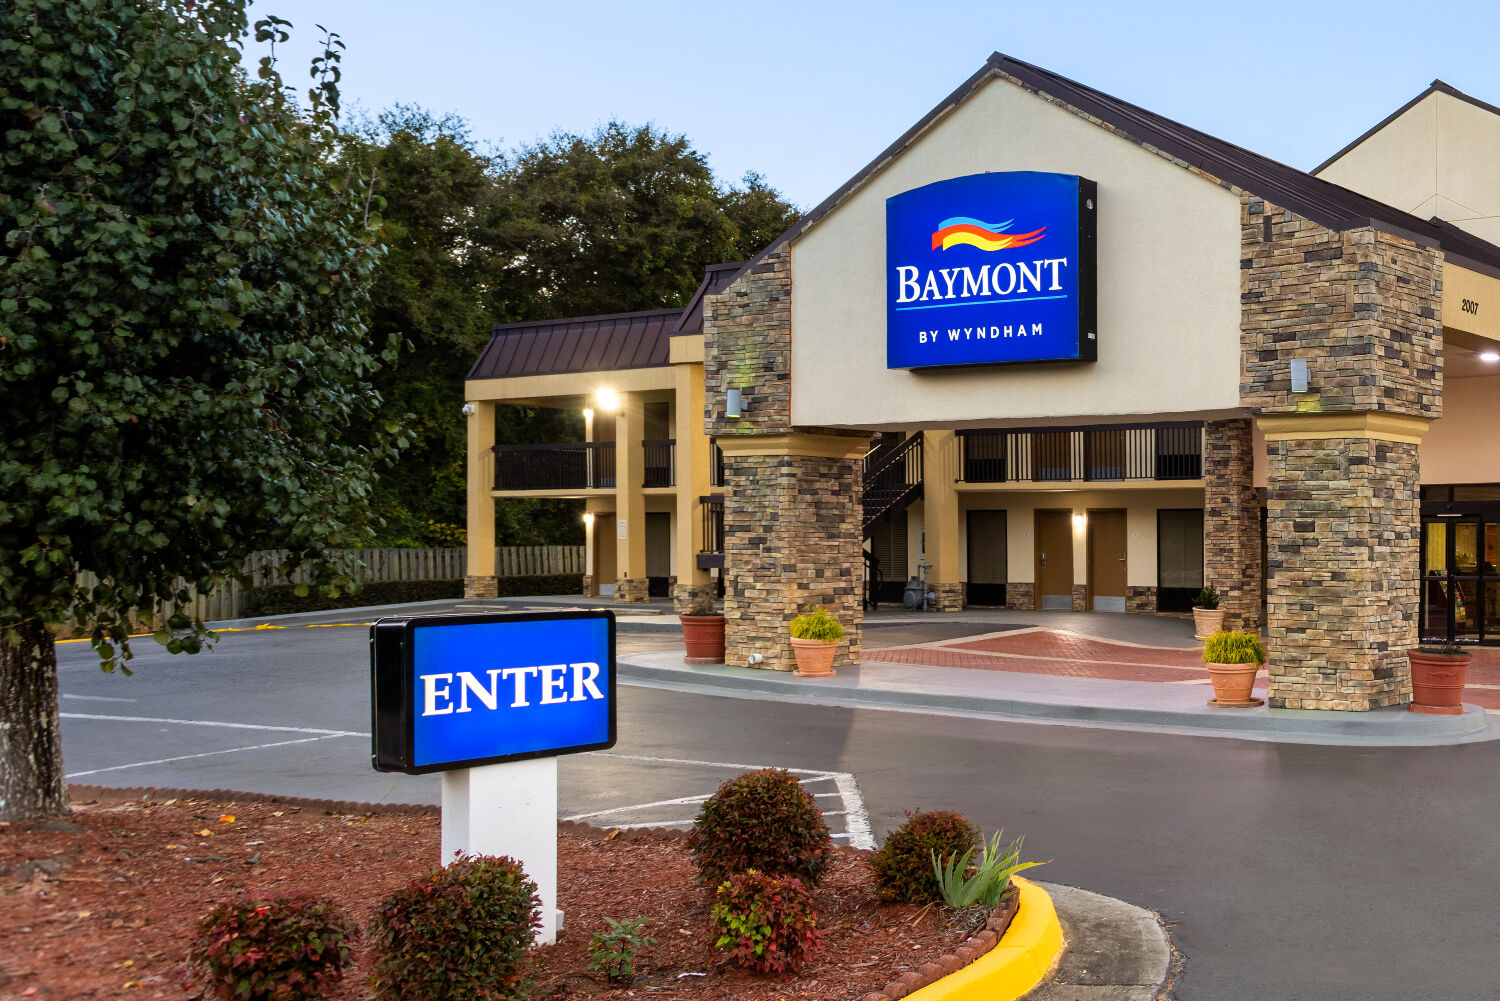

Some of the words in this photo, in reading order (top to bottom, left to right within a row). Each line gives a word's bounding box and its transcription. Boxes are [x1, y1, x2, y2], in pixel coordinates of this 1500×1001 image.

[896, 257, 1067, 303] BAYMONT
[1461, 299, 1479, 316] 2007
[919, 330, 938, 344] BY
[948, 323, 1043, 341] WYNDHAM
[419, 662, 604, 717] ENTER
